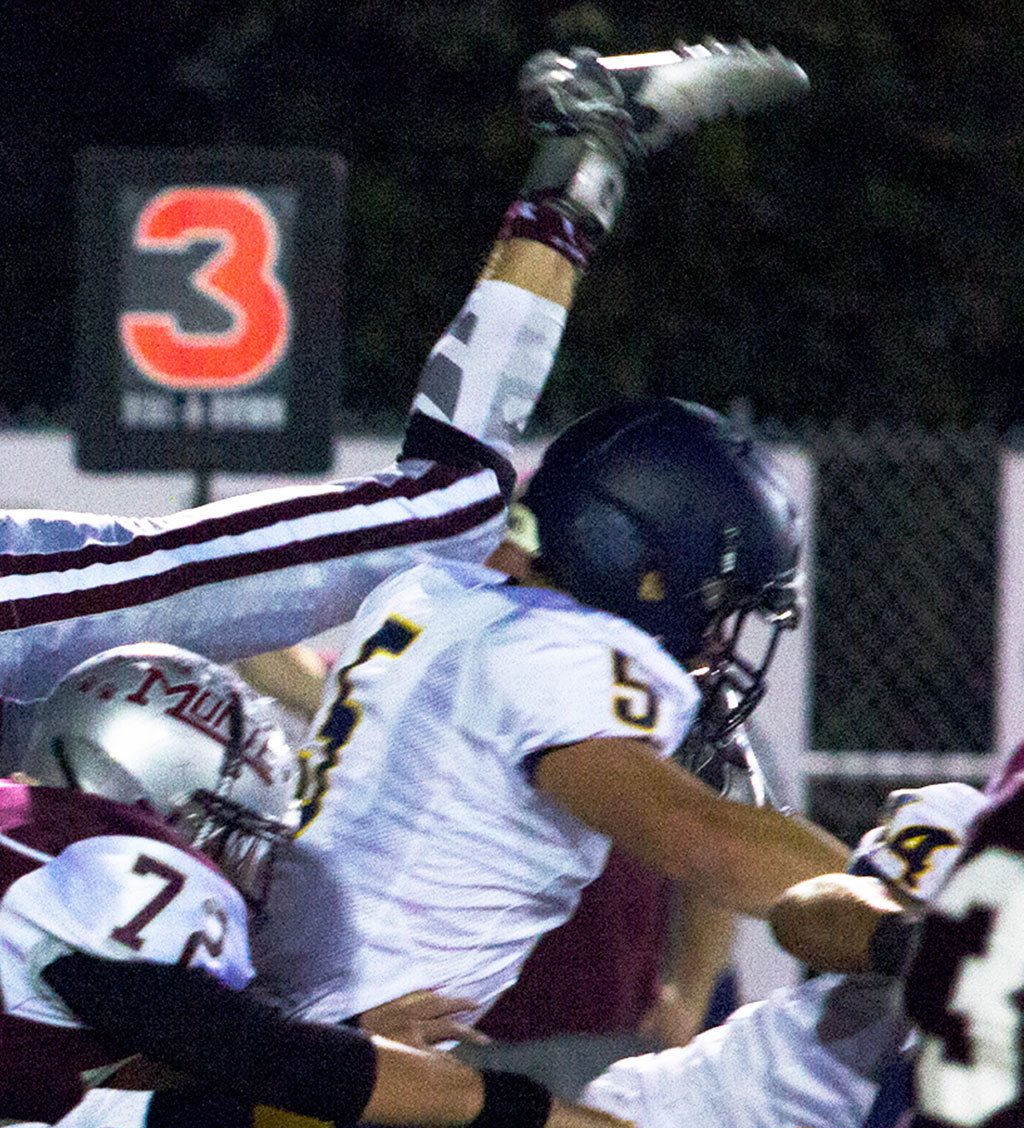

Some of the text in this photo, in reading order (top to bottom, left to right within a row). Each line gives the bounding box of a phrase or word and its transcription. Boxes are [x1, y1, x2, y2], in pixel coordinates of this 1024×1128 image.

[120, 186, 290, 389] 3
[611, 647, 662, 733] 5
[109, 854, 229, 968] 72
[913, 848, 1024, 1128] 3
